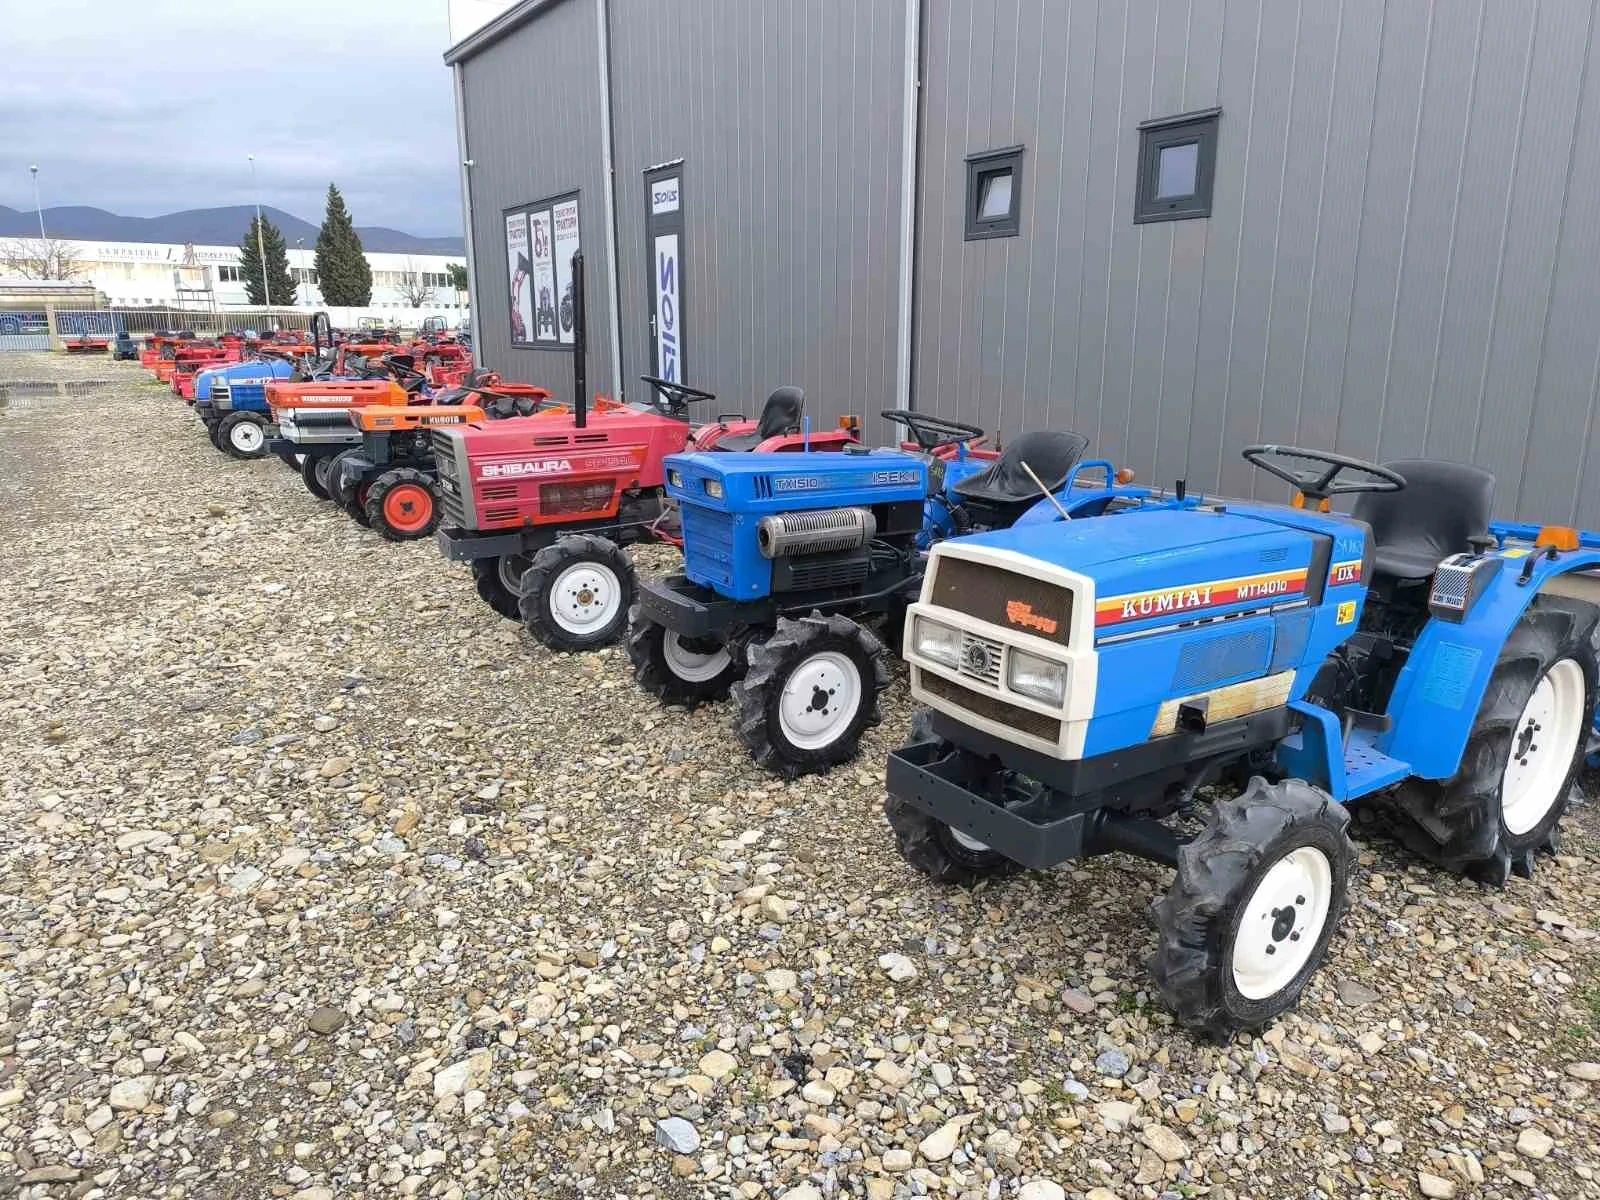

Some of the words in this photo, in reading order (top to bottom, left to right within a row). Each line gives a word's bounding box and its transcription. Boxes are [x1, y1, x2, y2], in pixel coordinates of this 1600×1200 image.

[481, 459, 573, 477] SHIBAURA
[872, 471, 917, 485] ISEKI
[1120, 585, 1215, 618] KUMIAI
[1337, 565, 1355, 582] DX
